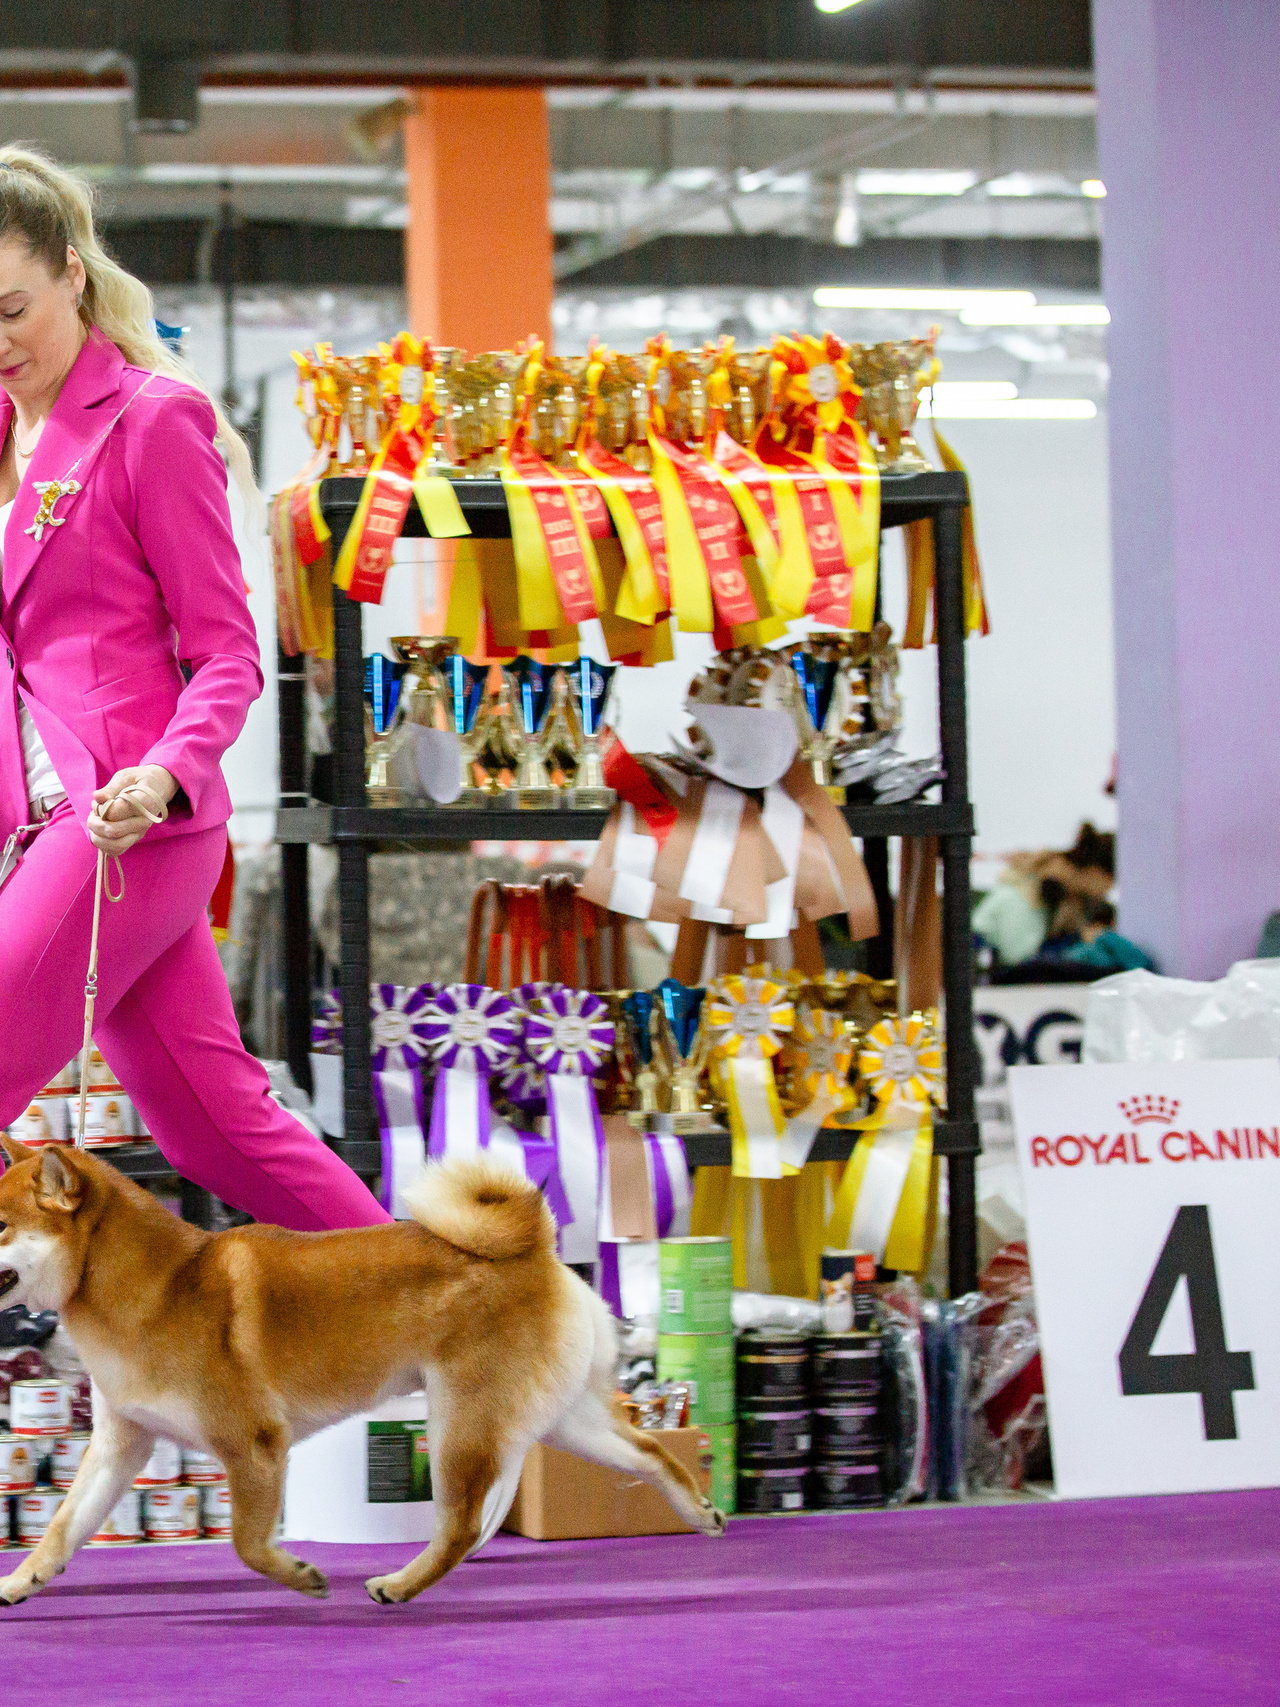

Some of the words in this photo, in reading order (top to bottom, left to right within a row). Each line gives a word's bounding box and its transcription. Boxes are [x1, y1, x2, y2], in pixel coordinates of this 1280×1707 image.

[366, 514, 399, 535] III
[548, 536, 581, 557] III
[1030, 1132, 1153, 1168] ROYAL
[1160, 1127, 1280, 1164] CANIN
[1116, 1204, 1256, 1440] 4
